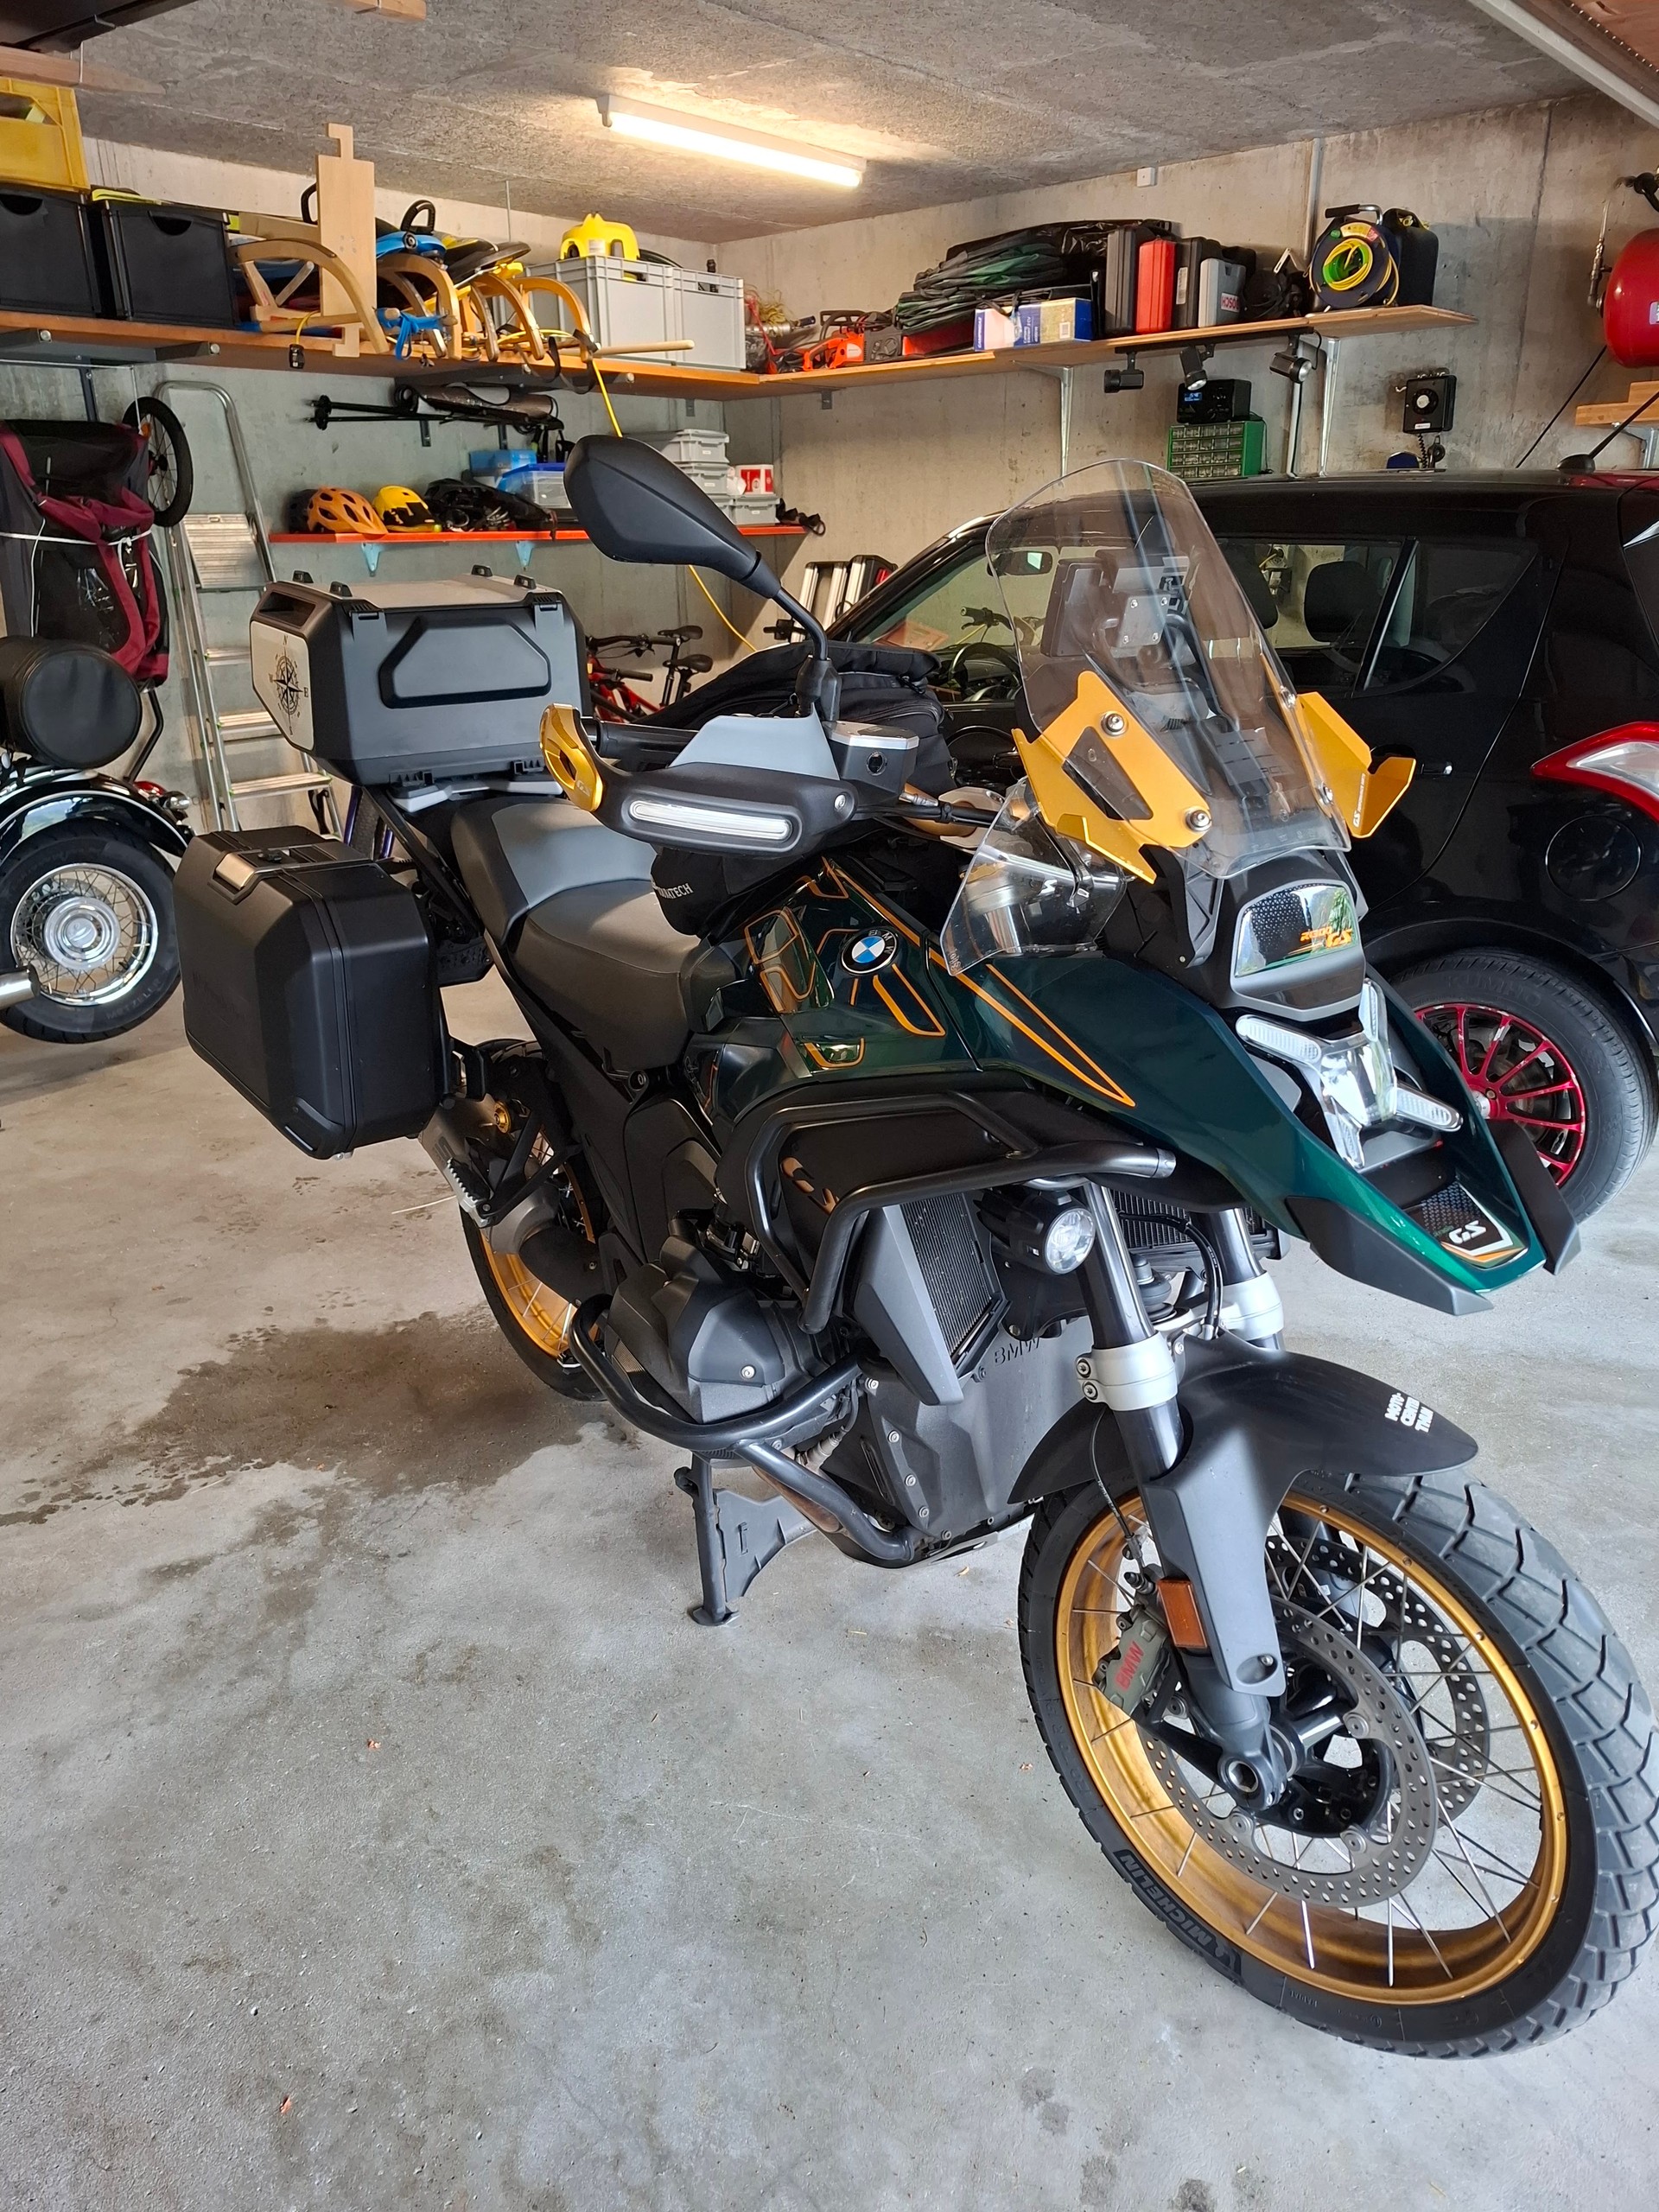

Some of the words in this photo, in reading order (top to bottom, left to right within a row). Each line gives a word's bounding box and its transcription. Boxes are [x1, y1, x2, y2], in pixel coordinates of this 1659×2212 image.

[1448, 1219, 1487, 1244] GS
[1116, 1640, 1144, 1691] BMW
[1121, 1853, 1213, 1947] MICHELIN
